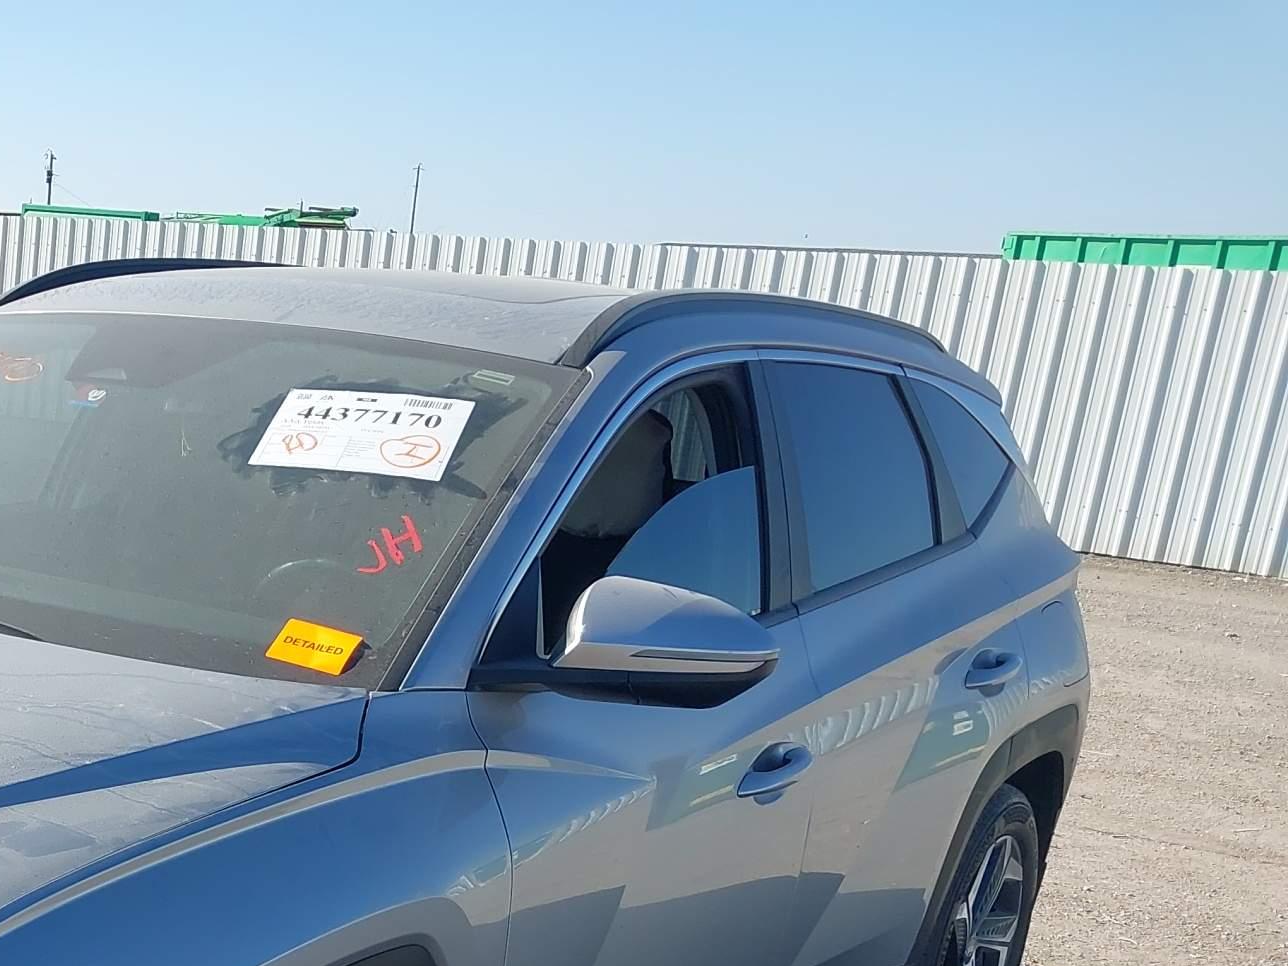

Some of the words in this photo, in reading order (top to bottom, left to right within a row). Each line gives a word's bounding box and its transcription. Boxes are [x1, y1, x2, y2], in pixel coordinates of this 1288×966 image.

[297, 405, 444, 429] 44377170
[355, 513, 424, 574] JH
[283, 635, 344, 655] DETAILED
